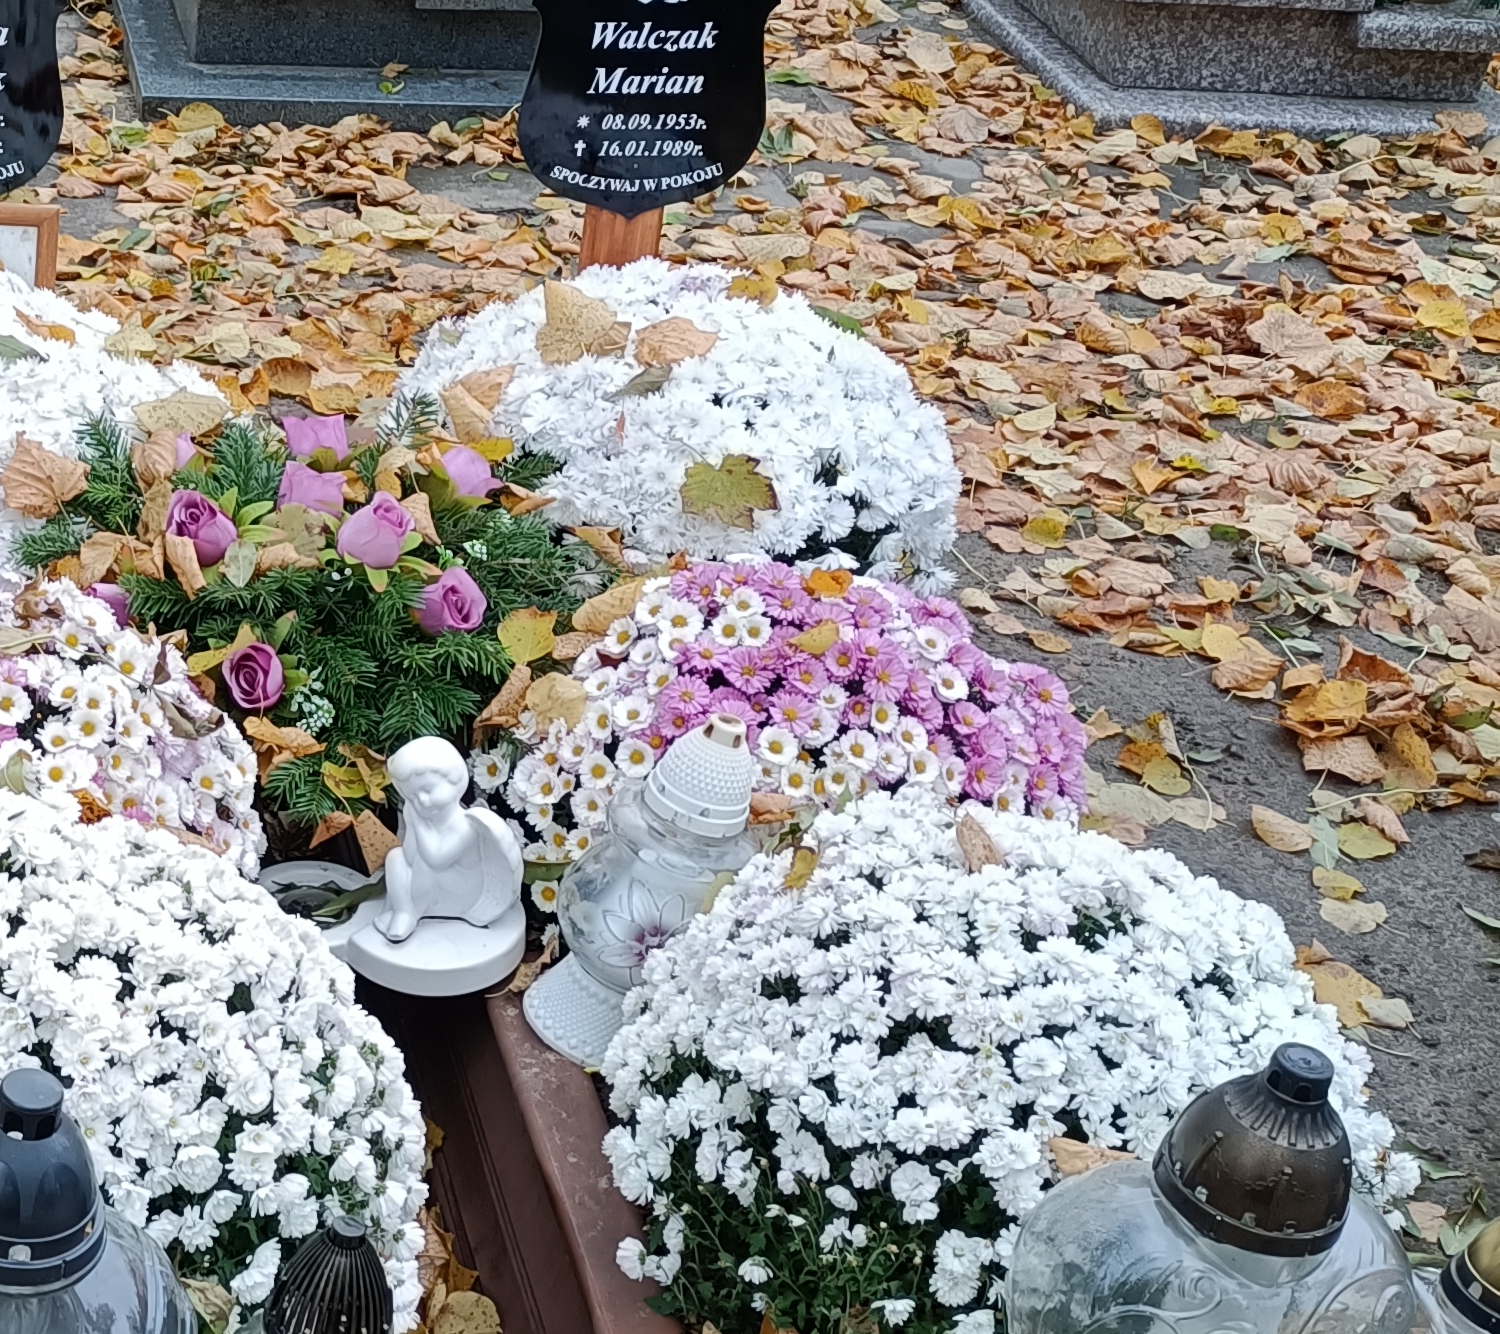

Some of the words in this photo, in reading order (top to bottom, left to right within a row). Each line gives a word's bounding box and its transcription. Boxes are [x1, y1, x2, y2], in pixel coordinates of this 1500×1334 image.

[590, 21, 720, 52] Walczak
[586, 66, 706, 95] Marian
[601, 113, 708, 131] 08.09.1953r.
[597, 139, 704, 158] 16.01.1989r.
[550, 165, 640, 193] SPOCZYWAJ
[642, 178, 659, 192] W
[660, 162, 723, 190] POKOJU
